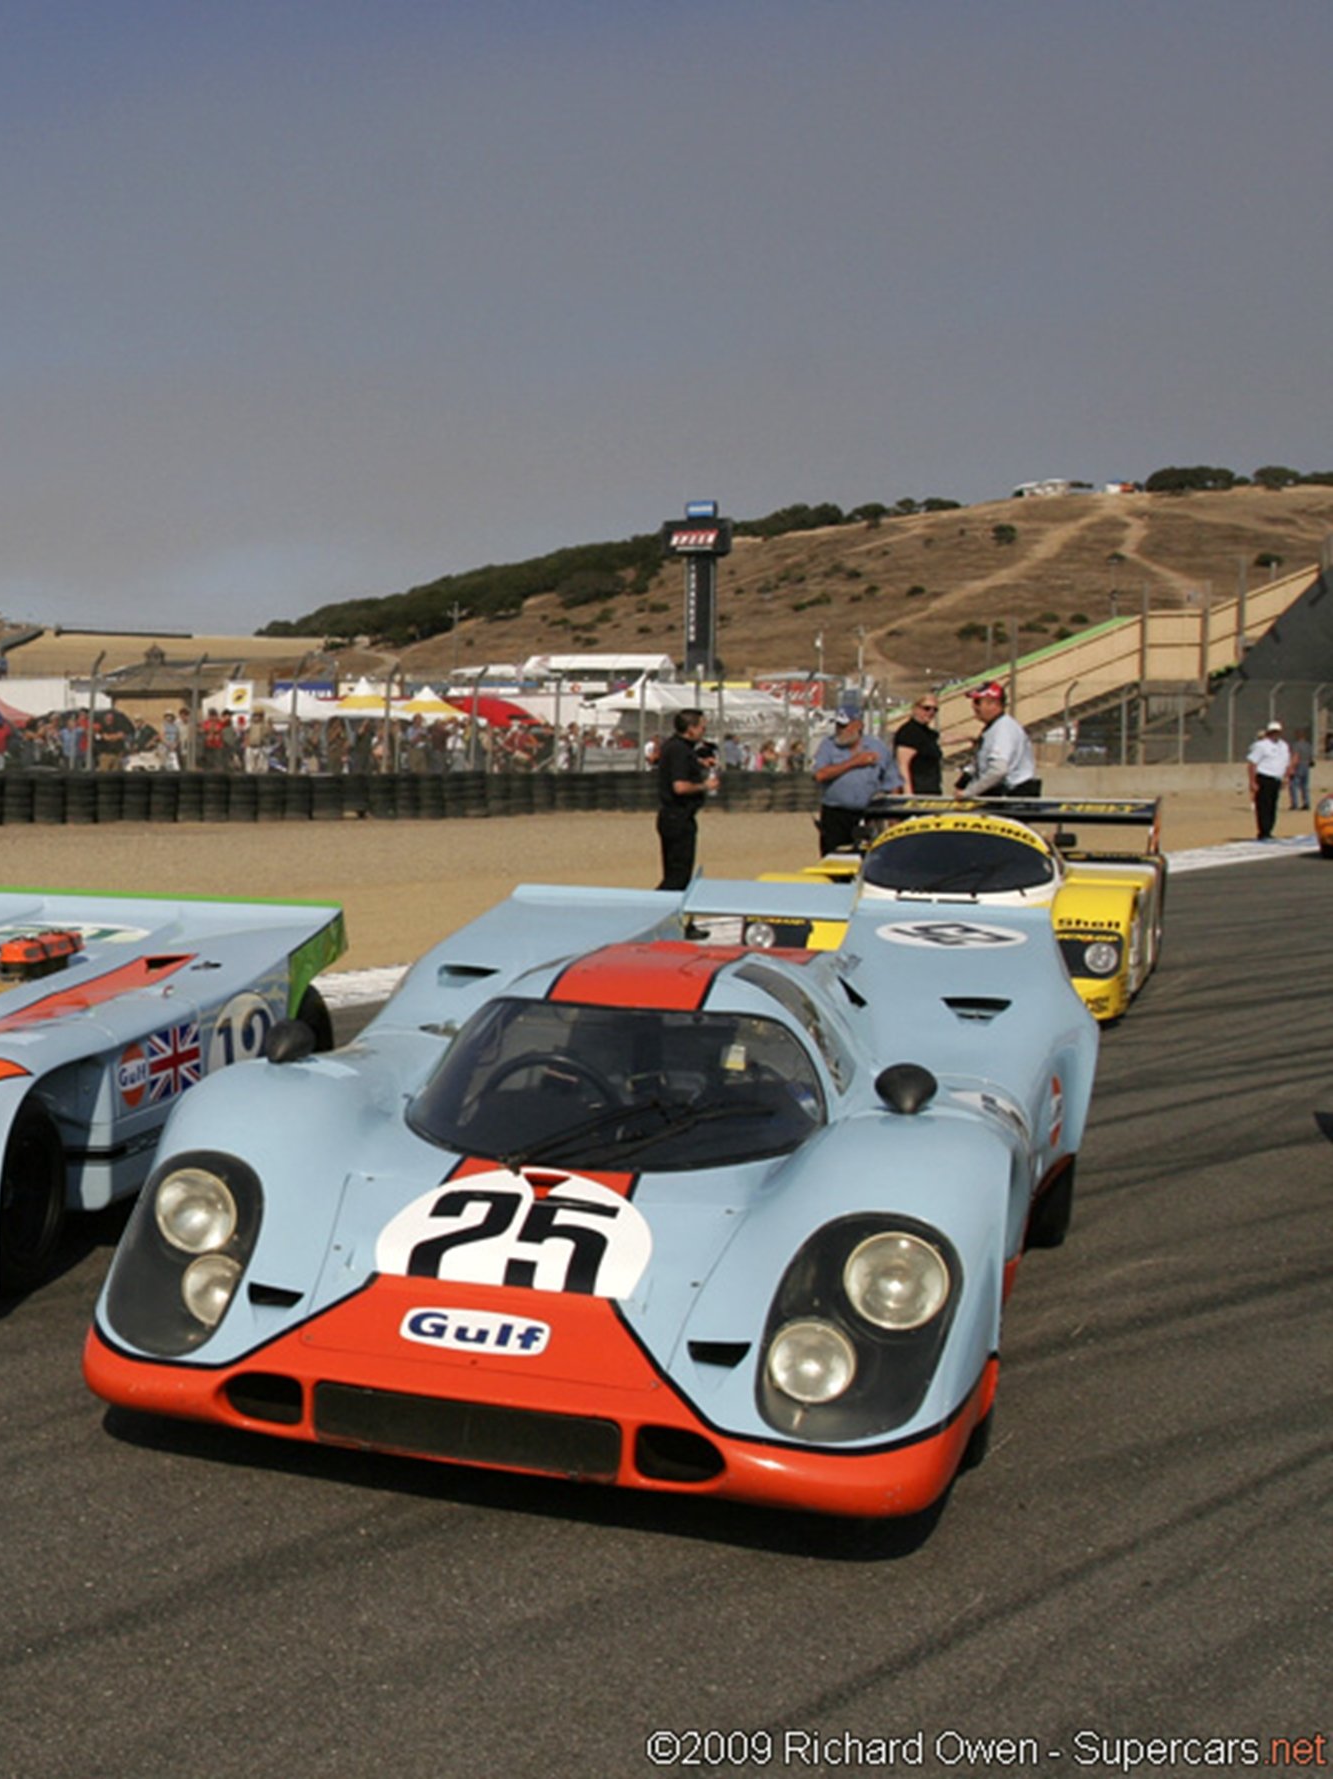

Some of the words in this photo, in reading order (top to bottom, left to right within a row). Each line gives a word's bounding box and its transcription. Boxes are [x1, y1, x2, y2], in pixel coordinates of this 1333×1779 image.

[118, 1061, 147, 1086] Gulf
[406, 1190, 621, 1296] 25
[408, 1312, 545, 1350] Gulf
